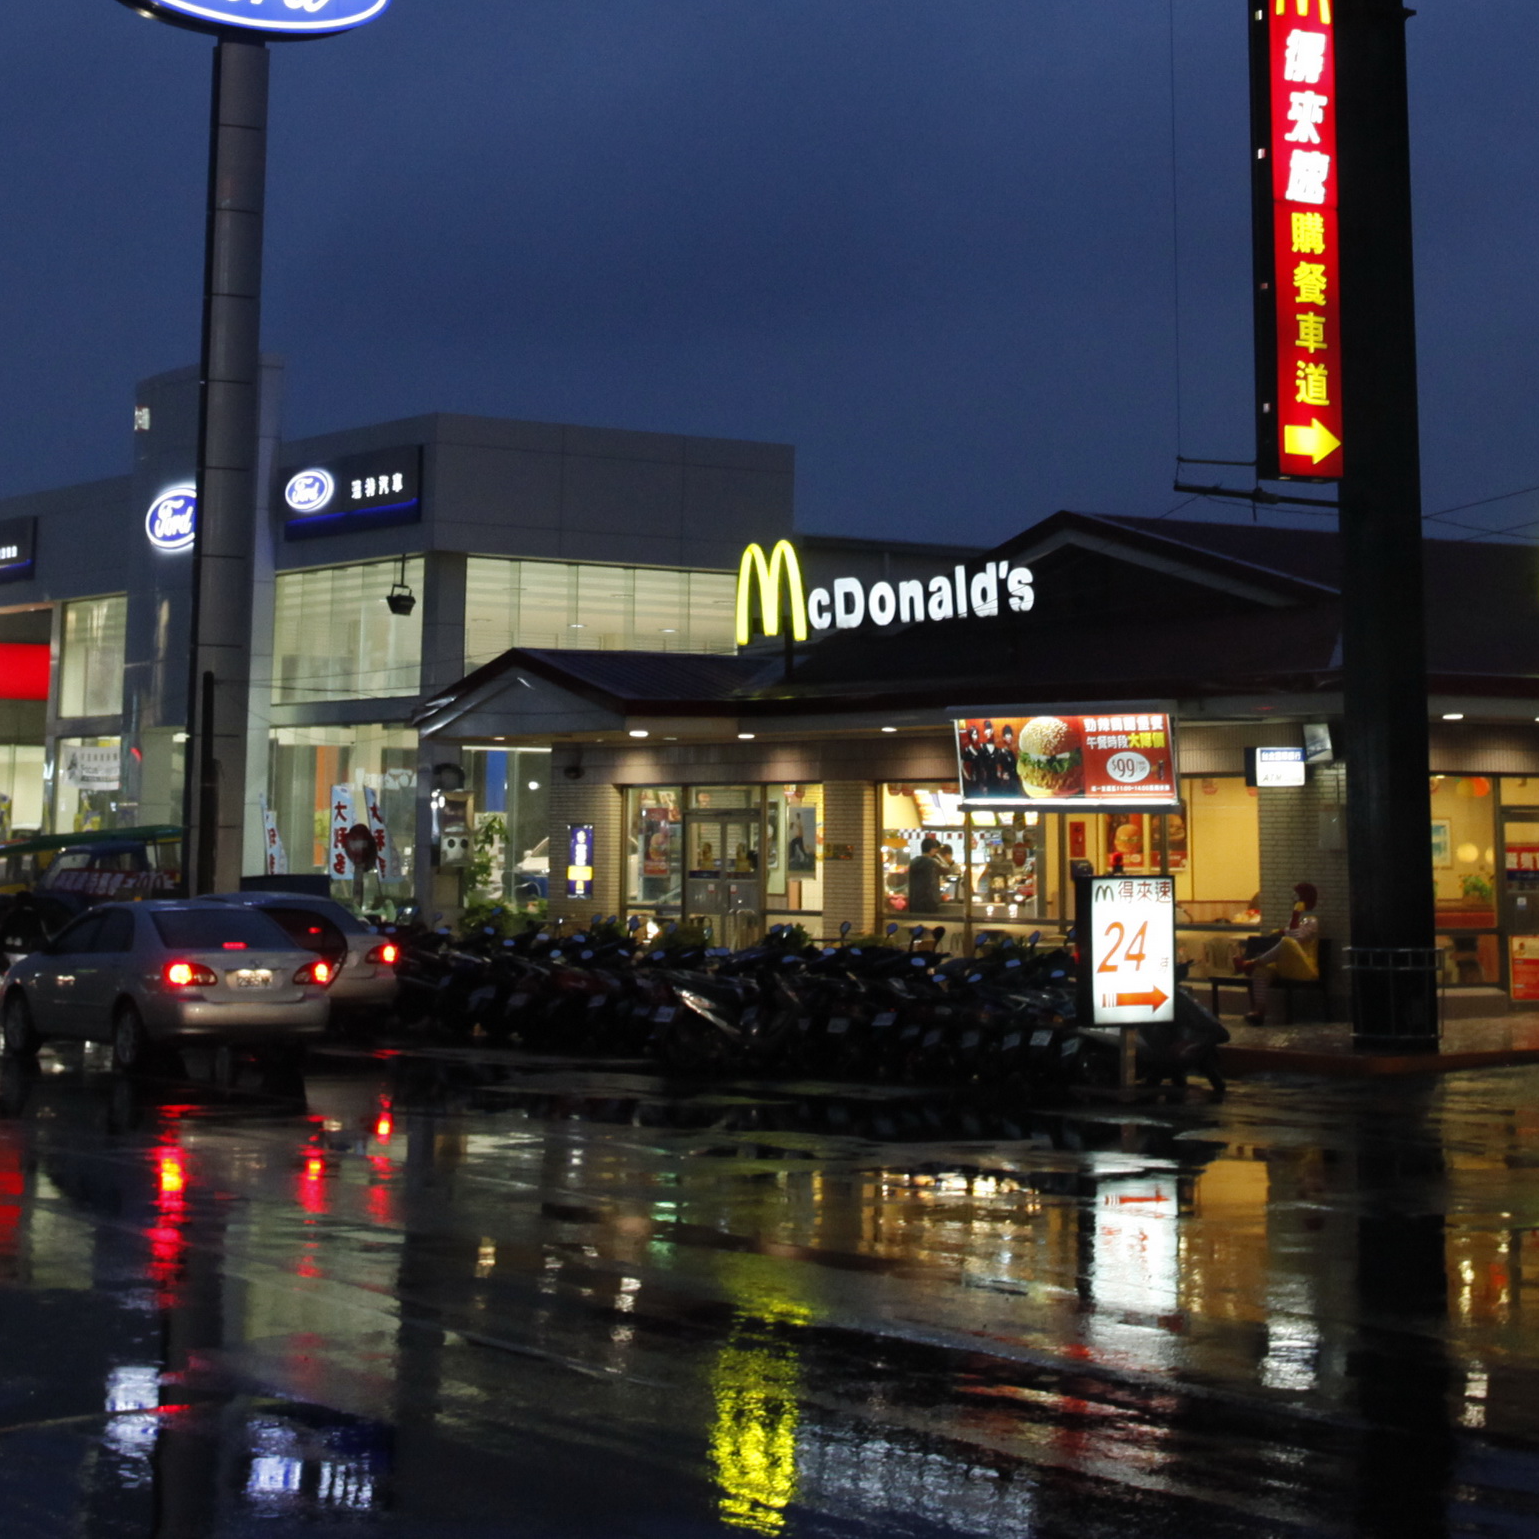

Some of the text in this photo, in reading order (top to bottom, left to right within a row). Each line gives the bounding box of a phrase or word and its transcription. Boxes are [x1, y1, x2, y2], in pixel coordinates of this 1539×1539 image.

[1283, 29, 1330, 205] 得來速
[1290, 211, 1330, 407] 購餐車道
[291, 476, 321, 504] Ford
[154, 498, 194, 539] Ford
[1117, 880, 1172, 904] 得來速
[1096, 920, 1149, 974] 24
